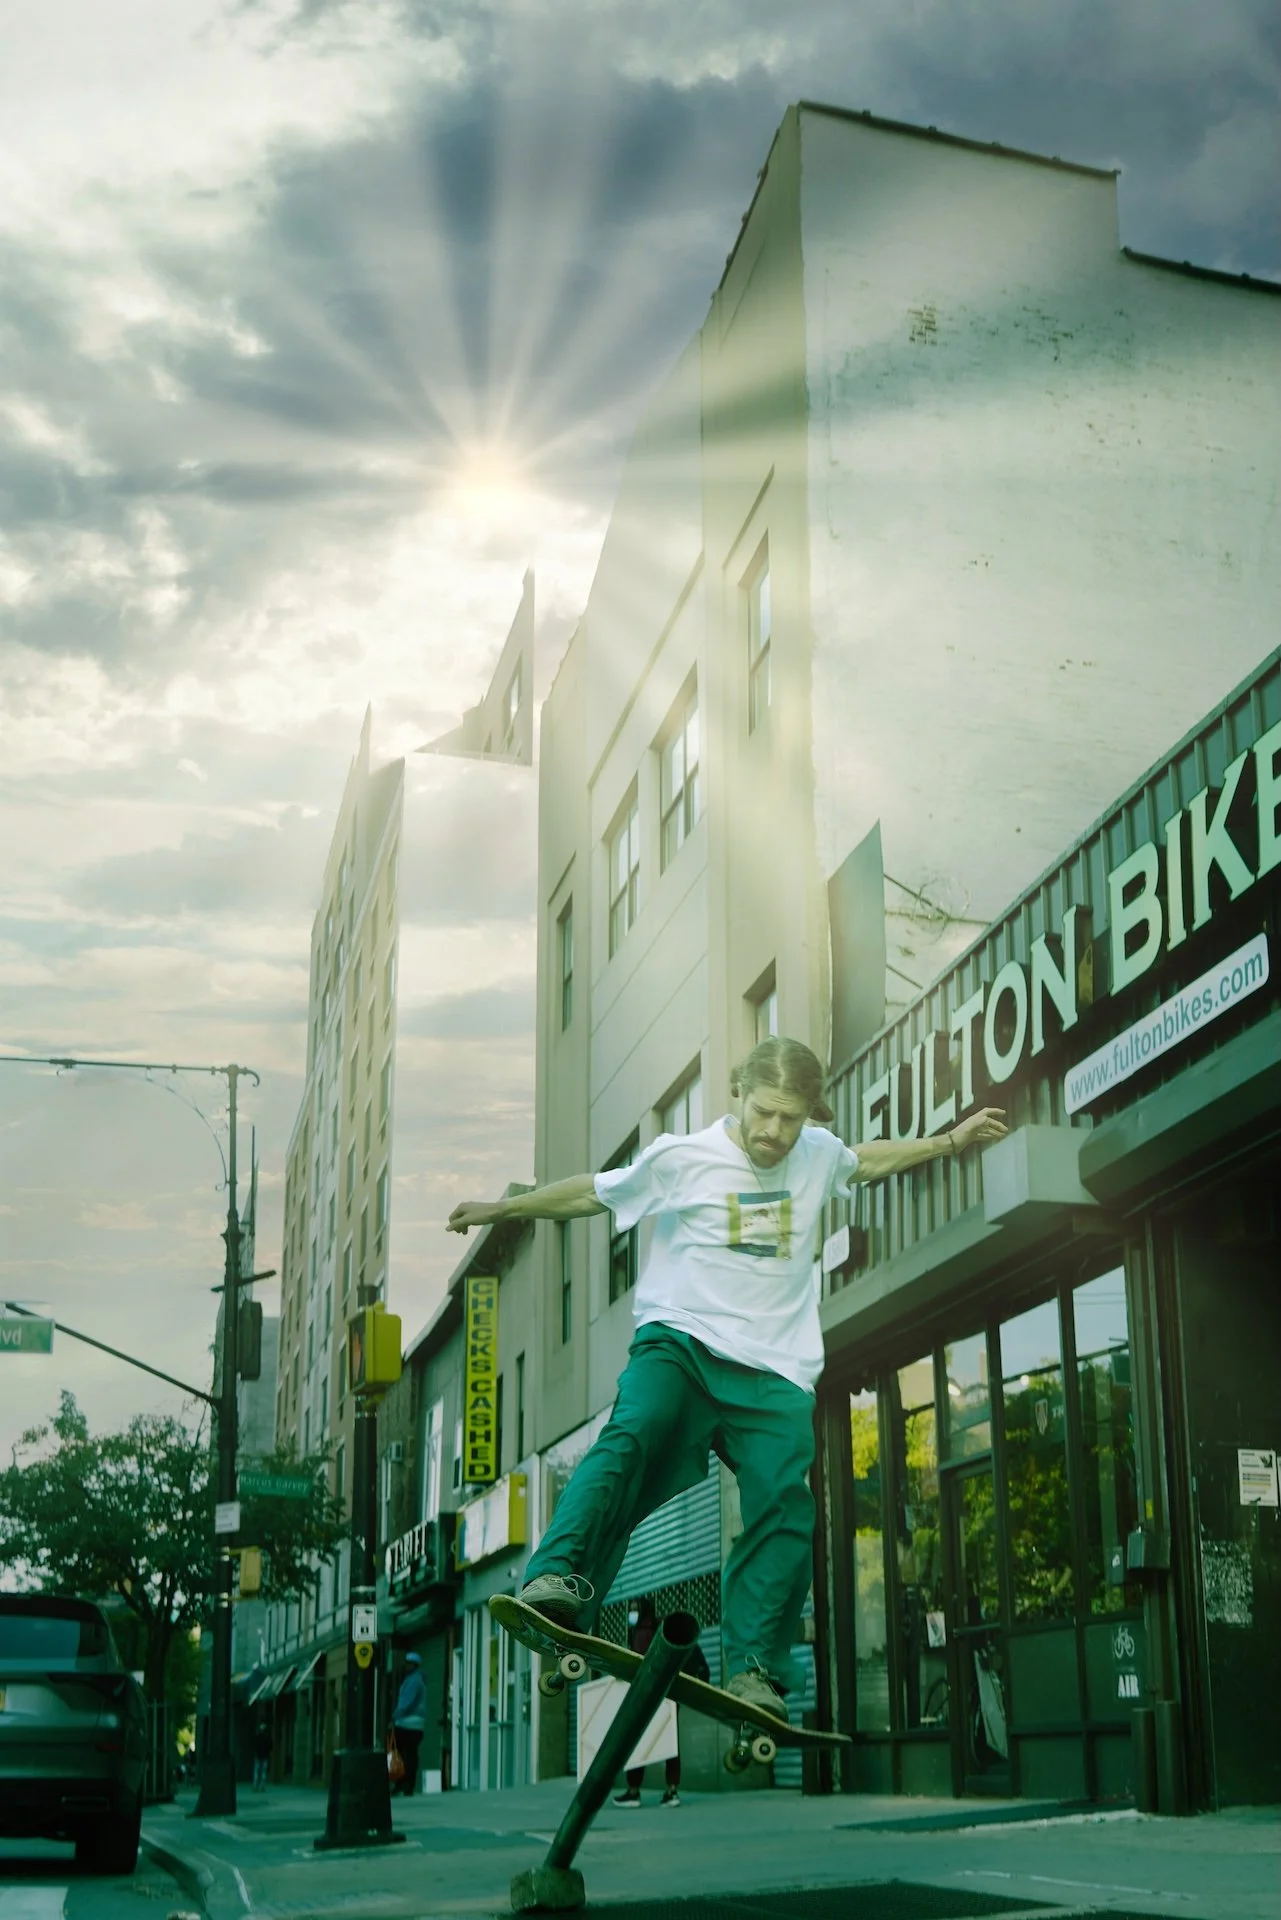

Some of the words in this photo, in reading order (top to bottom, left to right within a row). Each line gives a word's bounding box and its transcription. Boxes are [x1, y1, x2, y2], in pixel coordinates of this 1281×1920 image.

[862, 904, 1079, 1141] FULTON
[1070, 952, 1264, 1103] www.fultonbikes.com
[471, 1281, 494, 1373] CHECKS
[468, 1379, 492, 1477] CASHED
[240, 1473, 272, 1488] Marcus
[275, 1478, 309, 1494] Garvey
[1118, 1674, 1140, 1698] AIR
